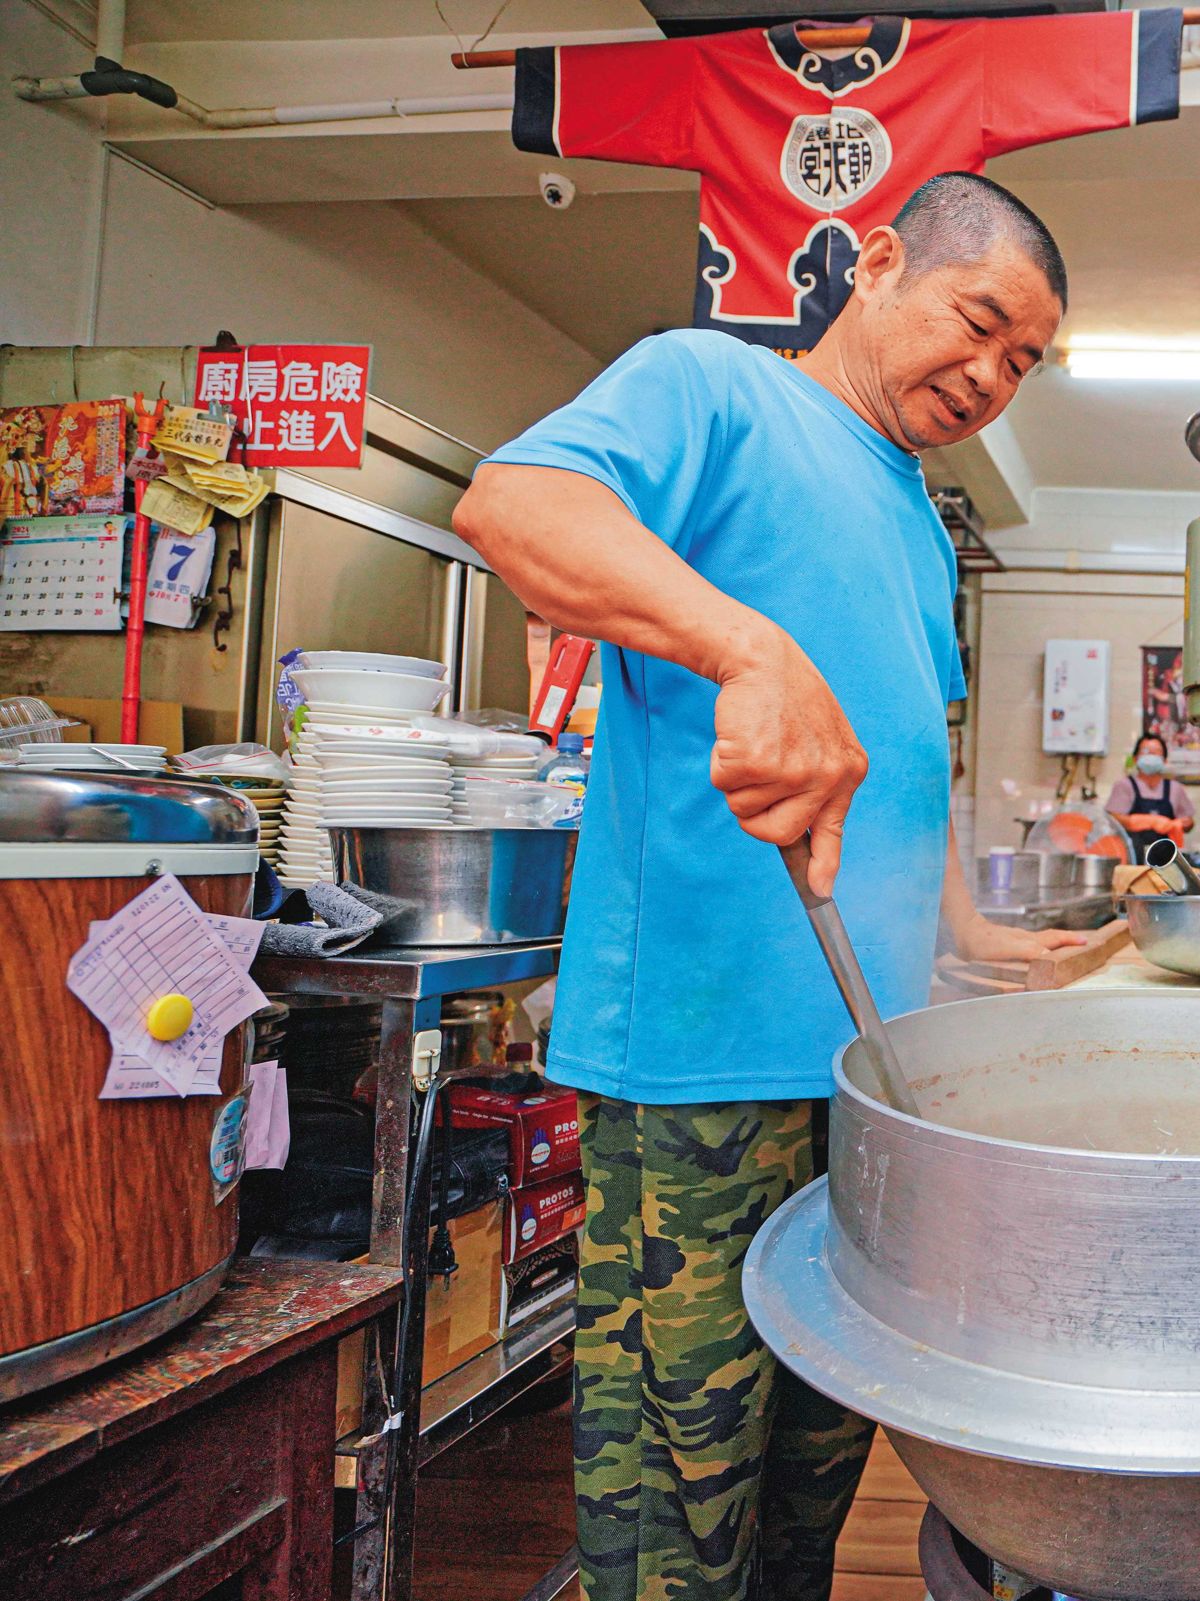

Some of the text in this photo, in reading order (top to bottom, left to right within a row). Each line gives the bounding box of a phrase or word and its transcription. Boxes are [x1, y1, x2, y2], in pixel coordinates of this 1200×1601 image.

[198, 360, 364, 403] 廚房危險
[236, 409, 358, 452] 止進入
[167, 543, 197, 582] 7
[554, 1120, 578, 1135] PRO
[539, 1186, 574, 1210] PROTOS
